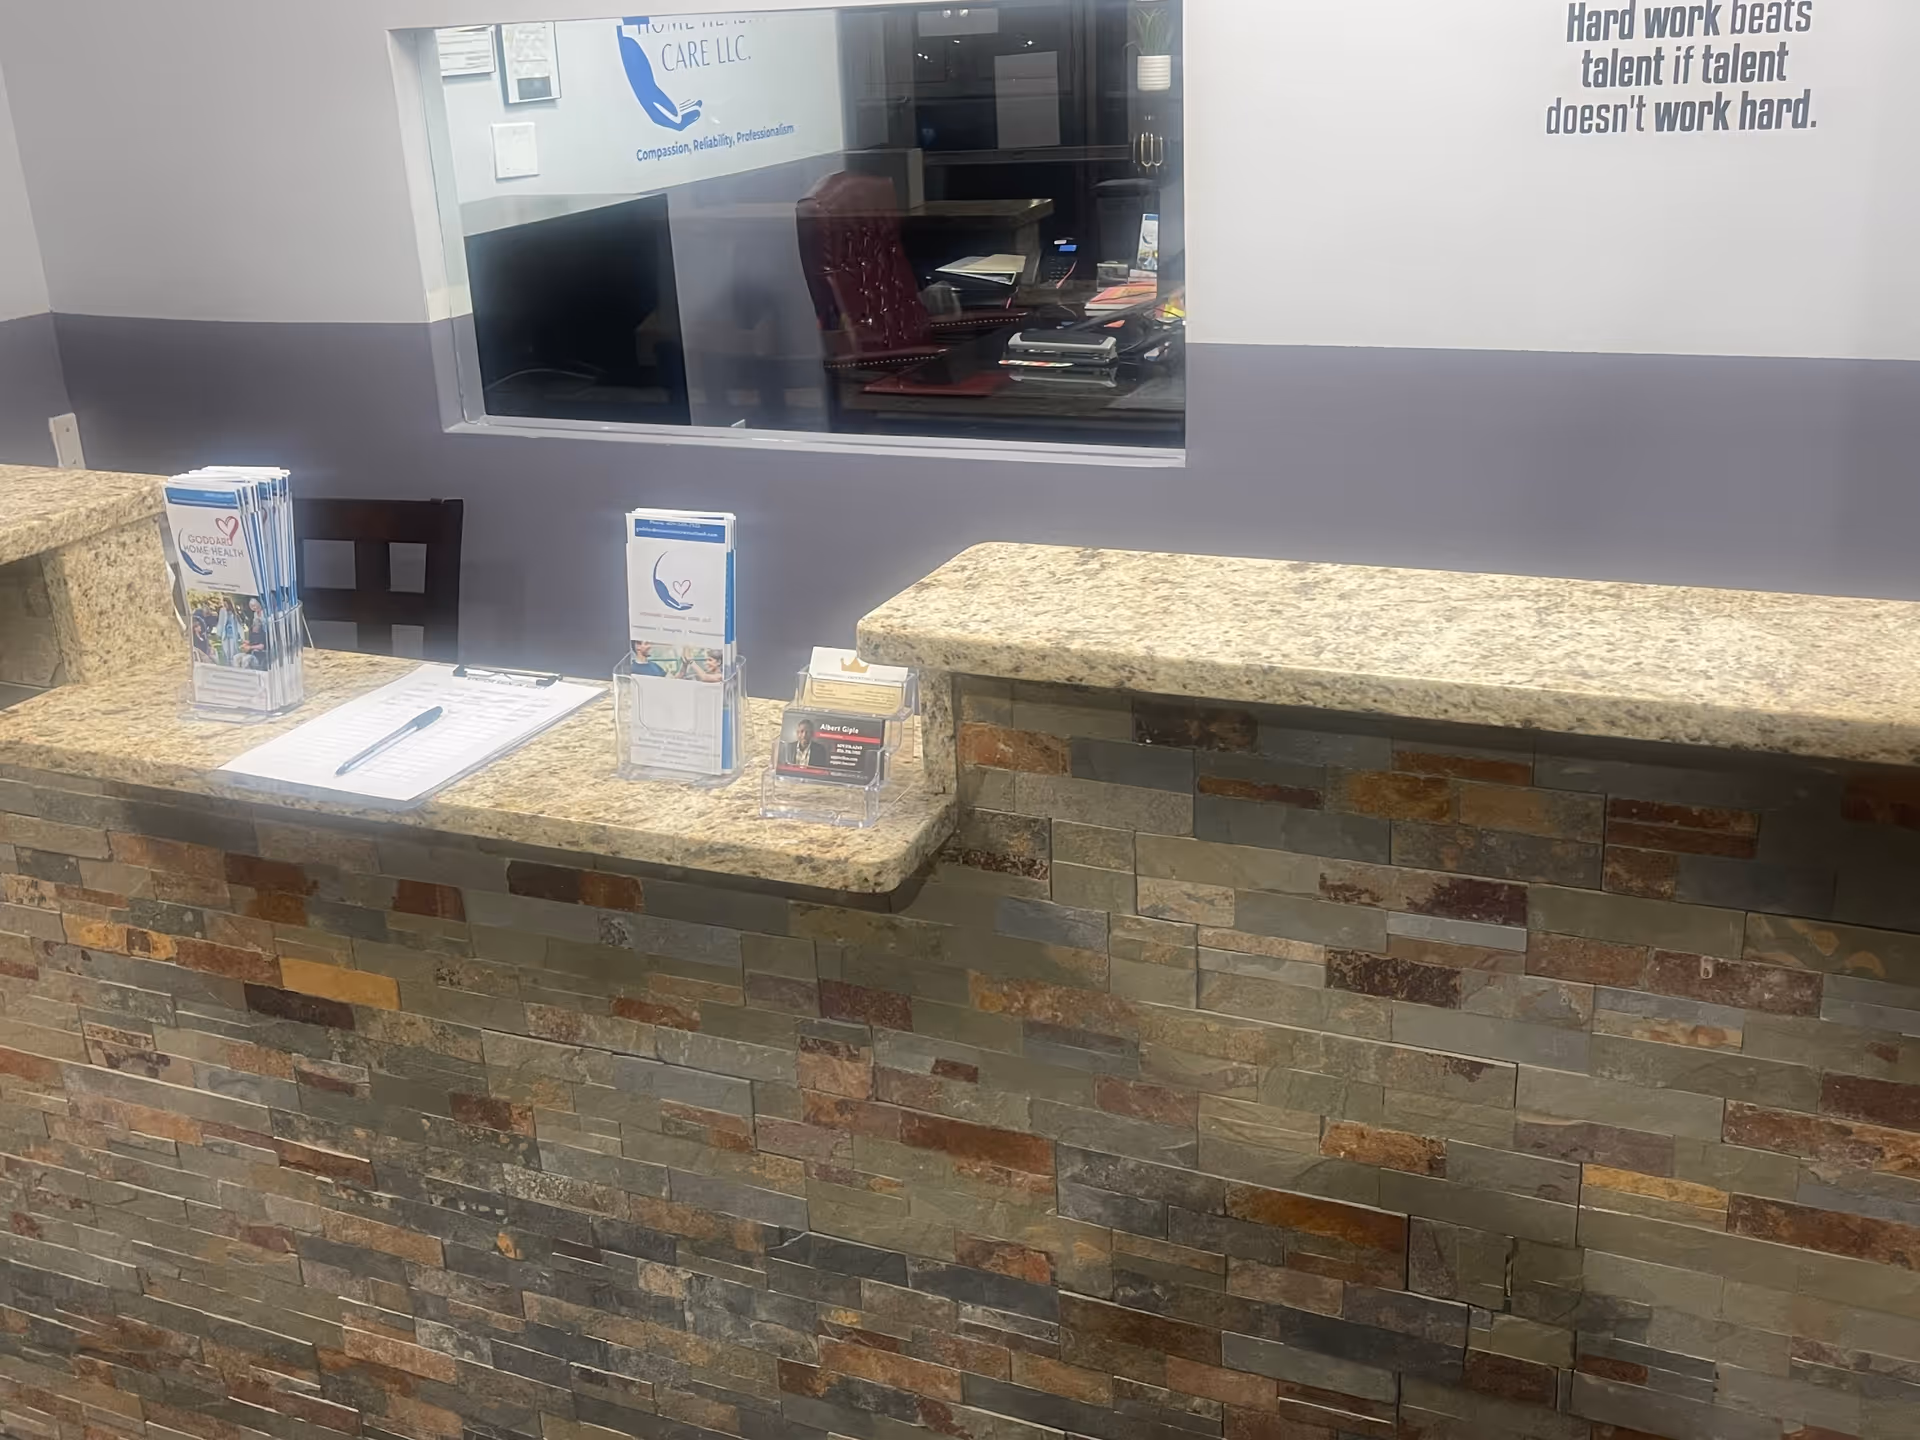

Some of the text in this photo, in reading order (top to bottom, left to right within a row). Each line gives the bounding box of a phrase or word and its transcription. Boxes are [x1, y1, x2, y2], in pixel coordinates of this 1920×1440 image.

[1566, 0, 1813, 42] Hard work beats
[661, 34, 751, 71] CARE LLC.
[1581, 41, 1789, 88] talent if talent
[1545, 88, 1817, 134] doesn't work hard.
[636, 122, 795, 161] Compassion, Reliability, Professionalism
[183, 544, 245, 558] HOME HEALTH
[188, 534, 233, 546] GODDARD
[203, 556, 228, 567] CARE
[819, 723, 841, 732] Albert
